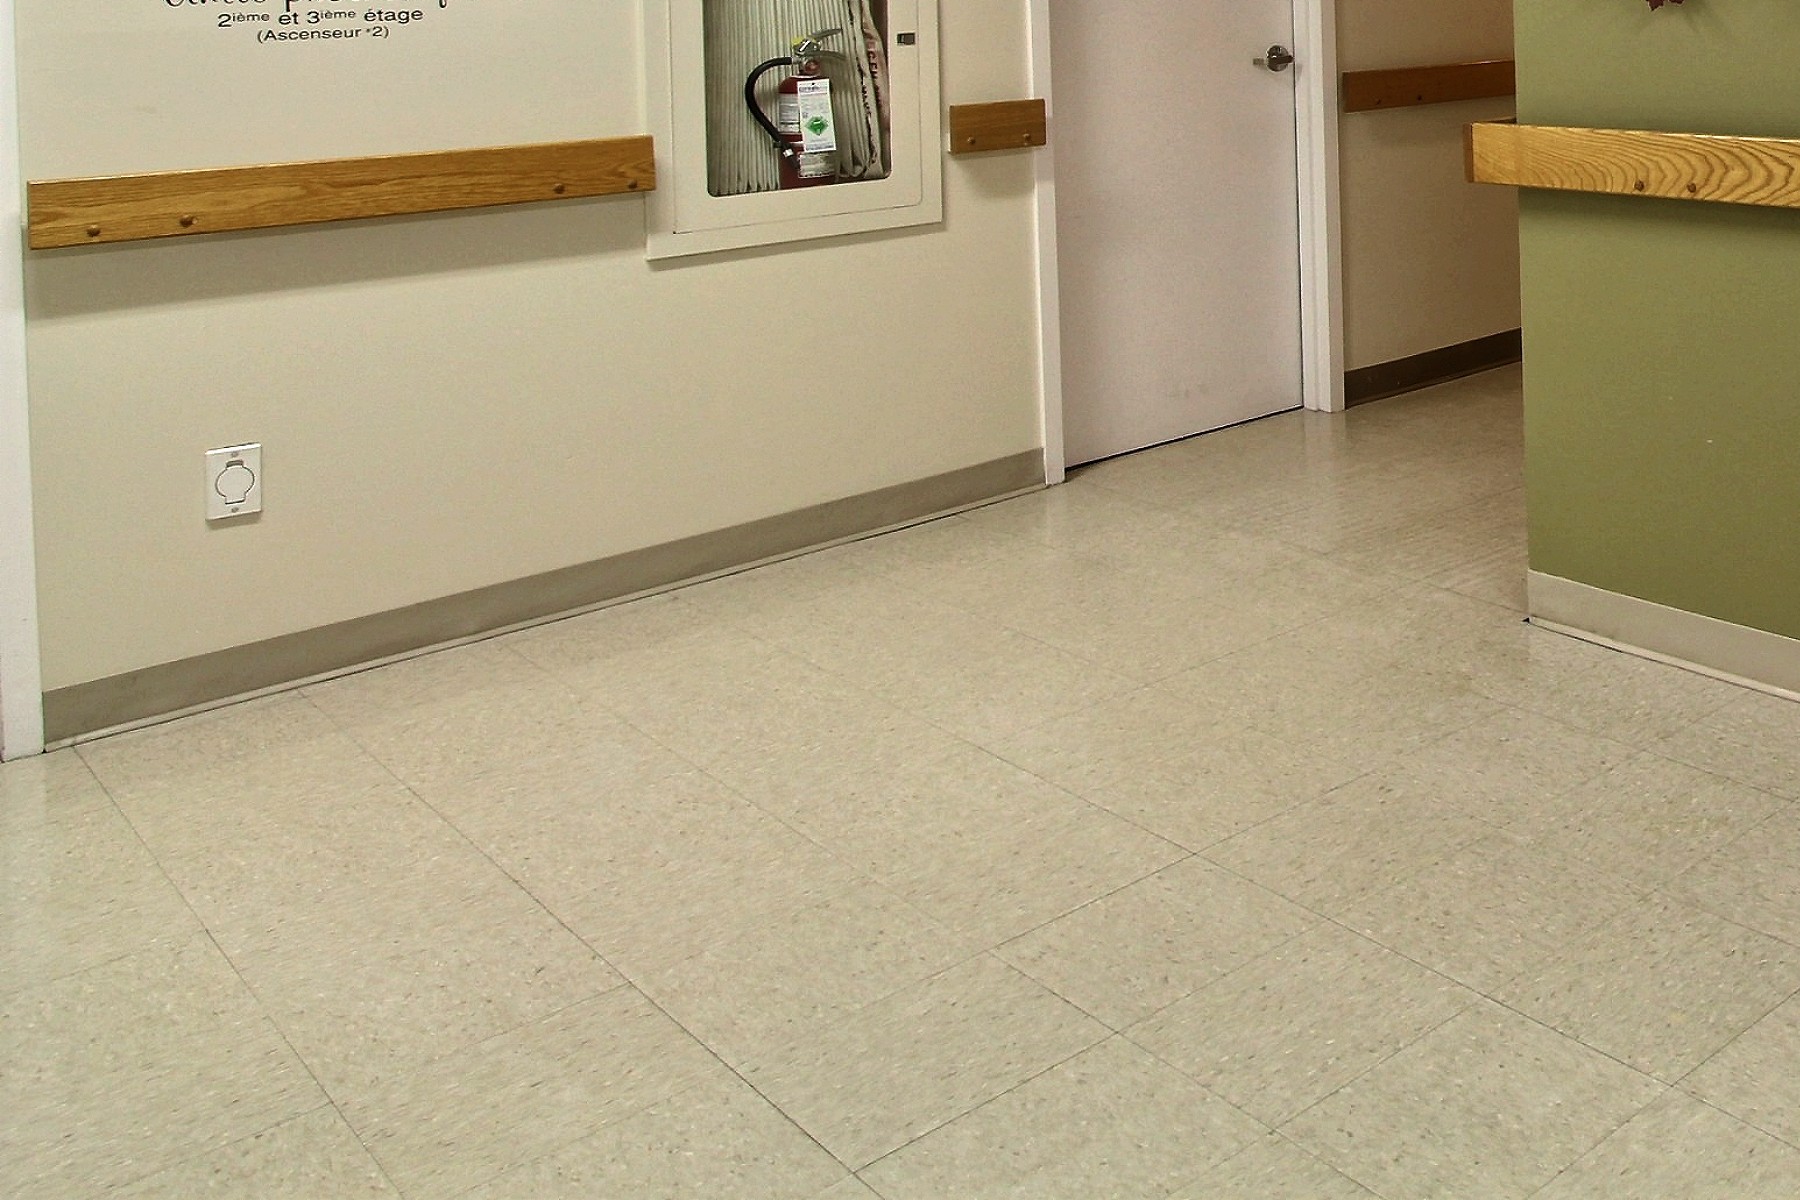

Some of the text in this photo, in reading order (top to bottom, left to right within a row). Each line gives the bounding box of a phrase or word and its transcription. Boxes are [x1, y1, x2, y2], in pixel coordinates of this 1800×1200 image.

[217, 8, 424, 28] 2ième et 3ième étage
[257, 27, 362, 44] (Ascenseur
